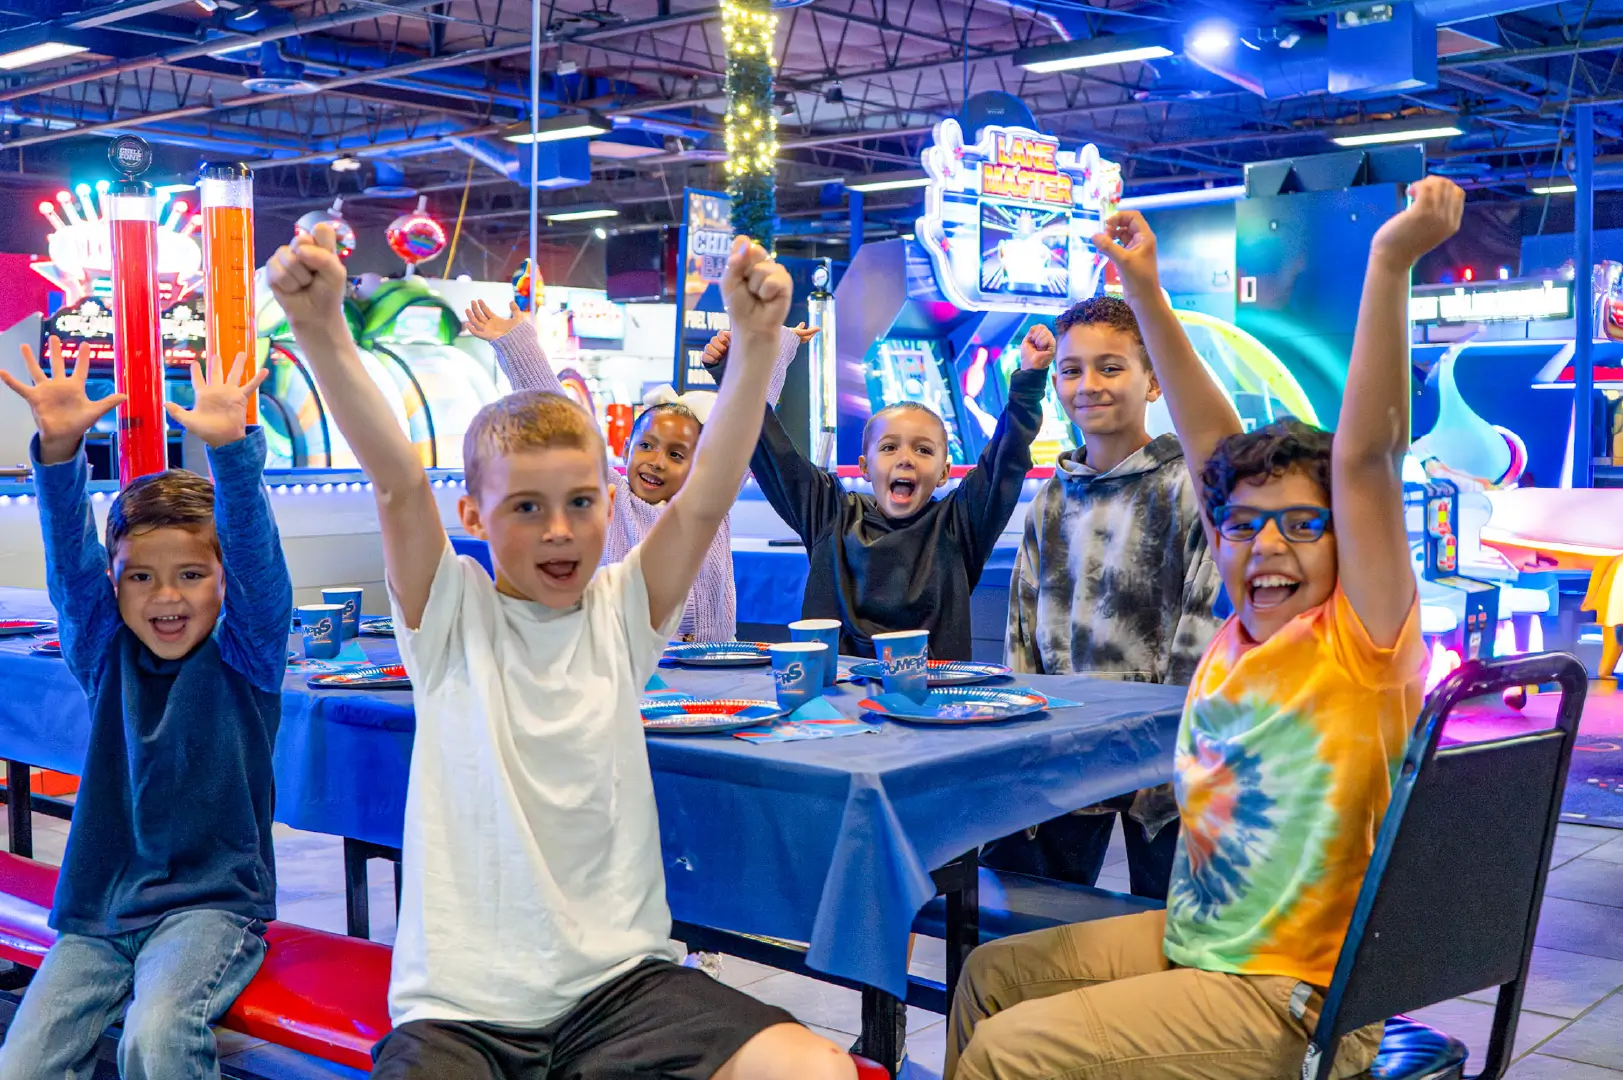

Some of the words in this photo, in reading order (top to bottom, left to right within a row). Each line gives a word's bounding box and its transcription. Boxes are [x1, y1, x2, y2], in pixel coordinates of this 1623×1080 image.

[997, 136, 1057, 174] LANE
[983, 163, 1073, 205] MASTER
[704, 255, 724, 278] BA
